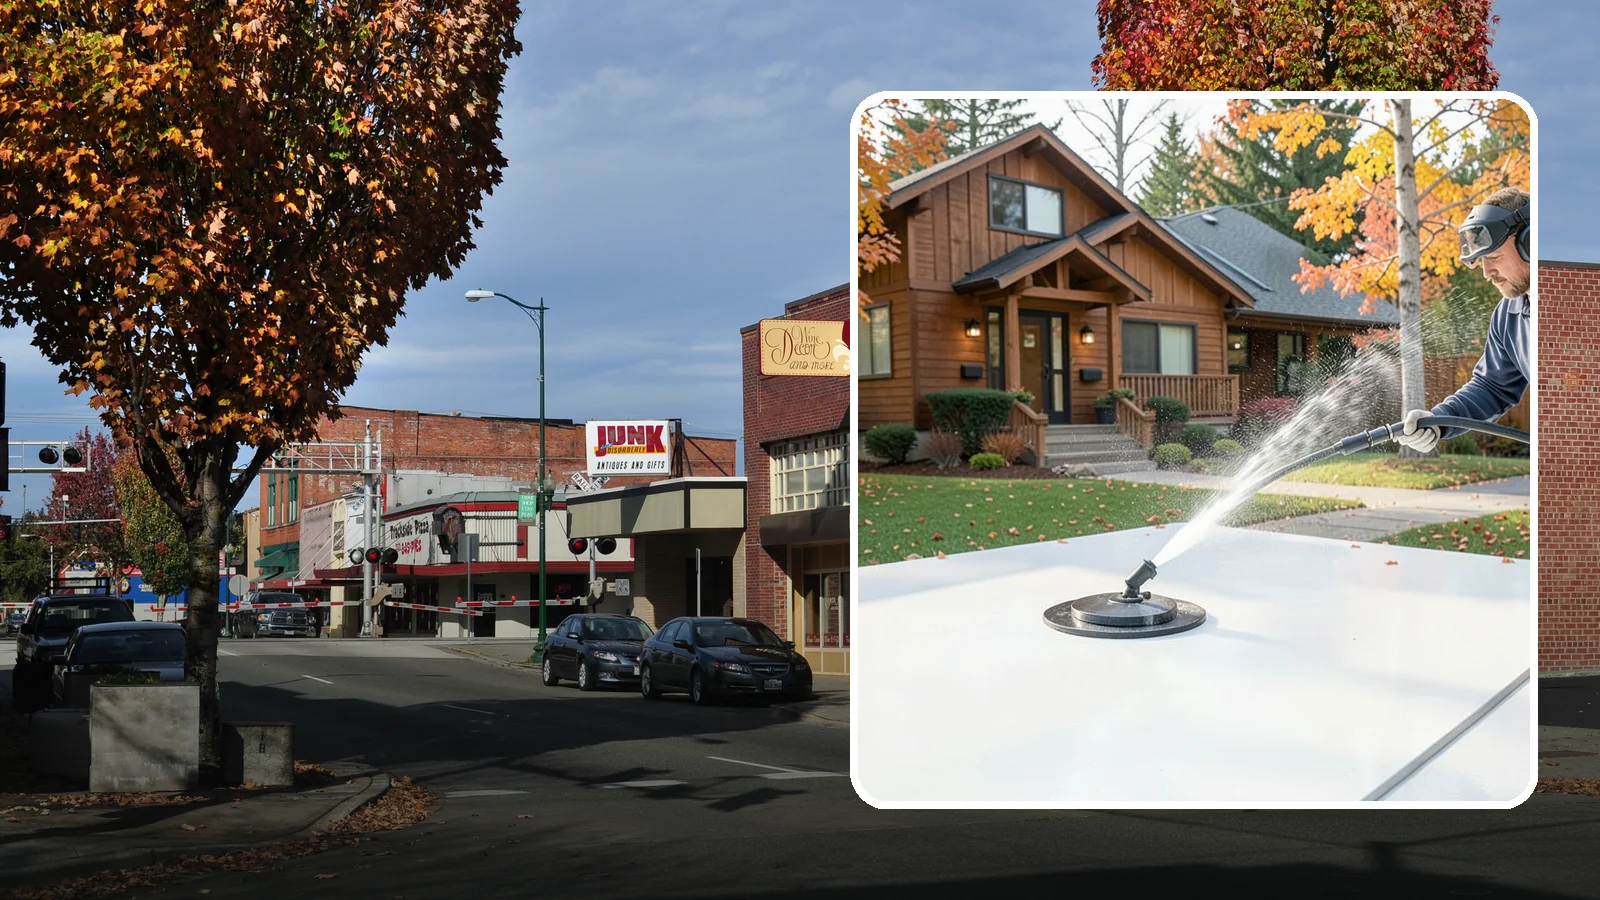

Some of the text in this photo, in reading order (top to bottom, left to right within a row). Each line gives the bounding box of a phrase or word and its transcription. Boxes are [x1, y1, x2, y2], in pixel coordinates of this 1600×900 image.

[595, 425, 666, 457] JUNK
[607, 446, 646, 454] DISORDERLY
[597, 460, 666, 470] ANTIQUES AND GIFTS
[414, 519, 429, 535] Pizza
